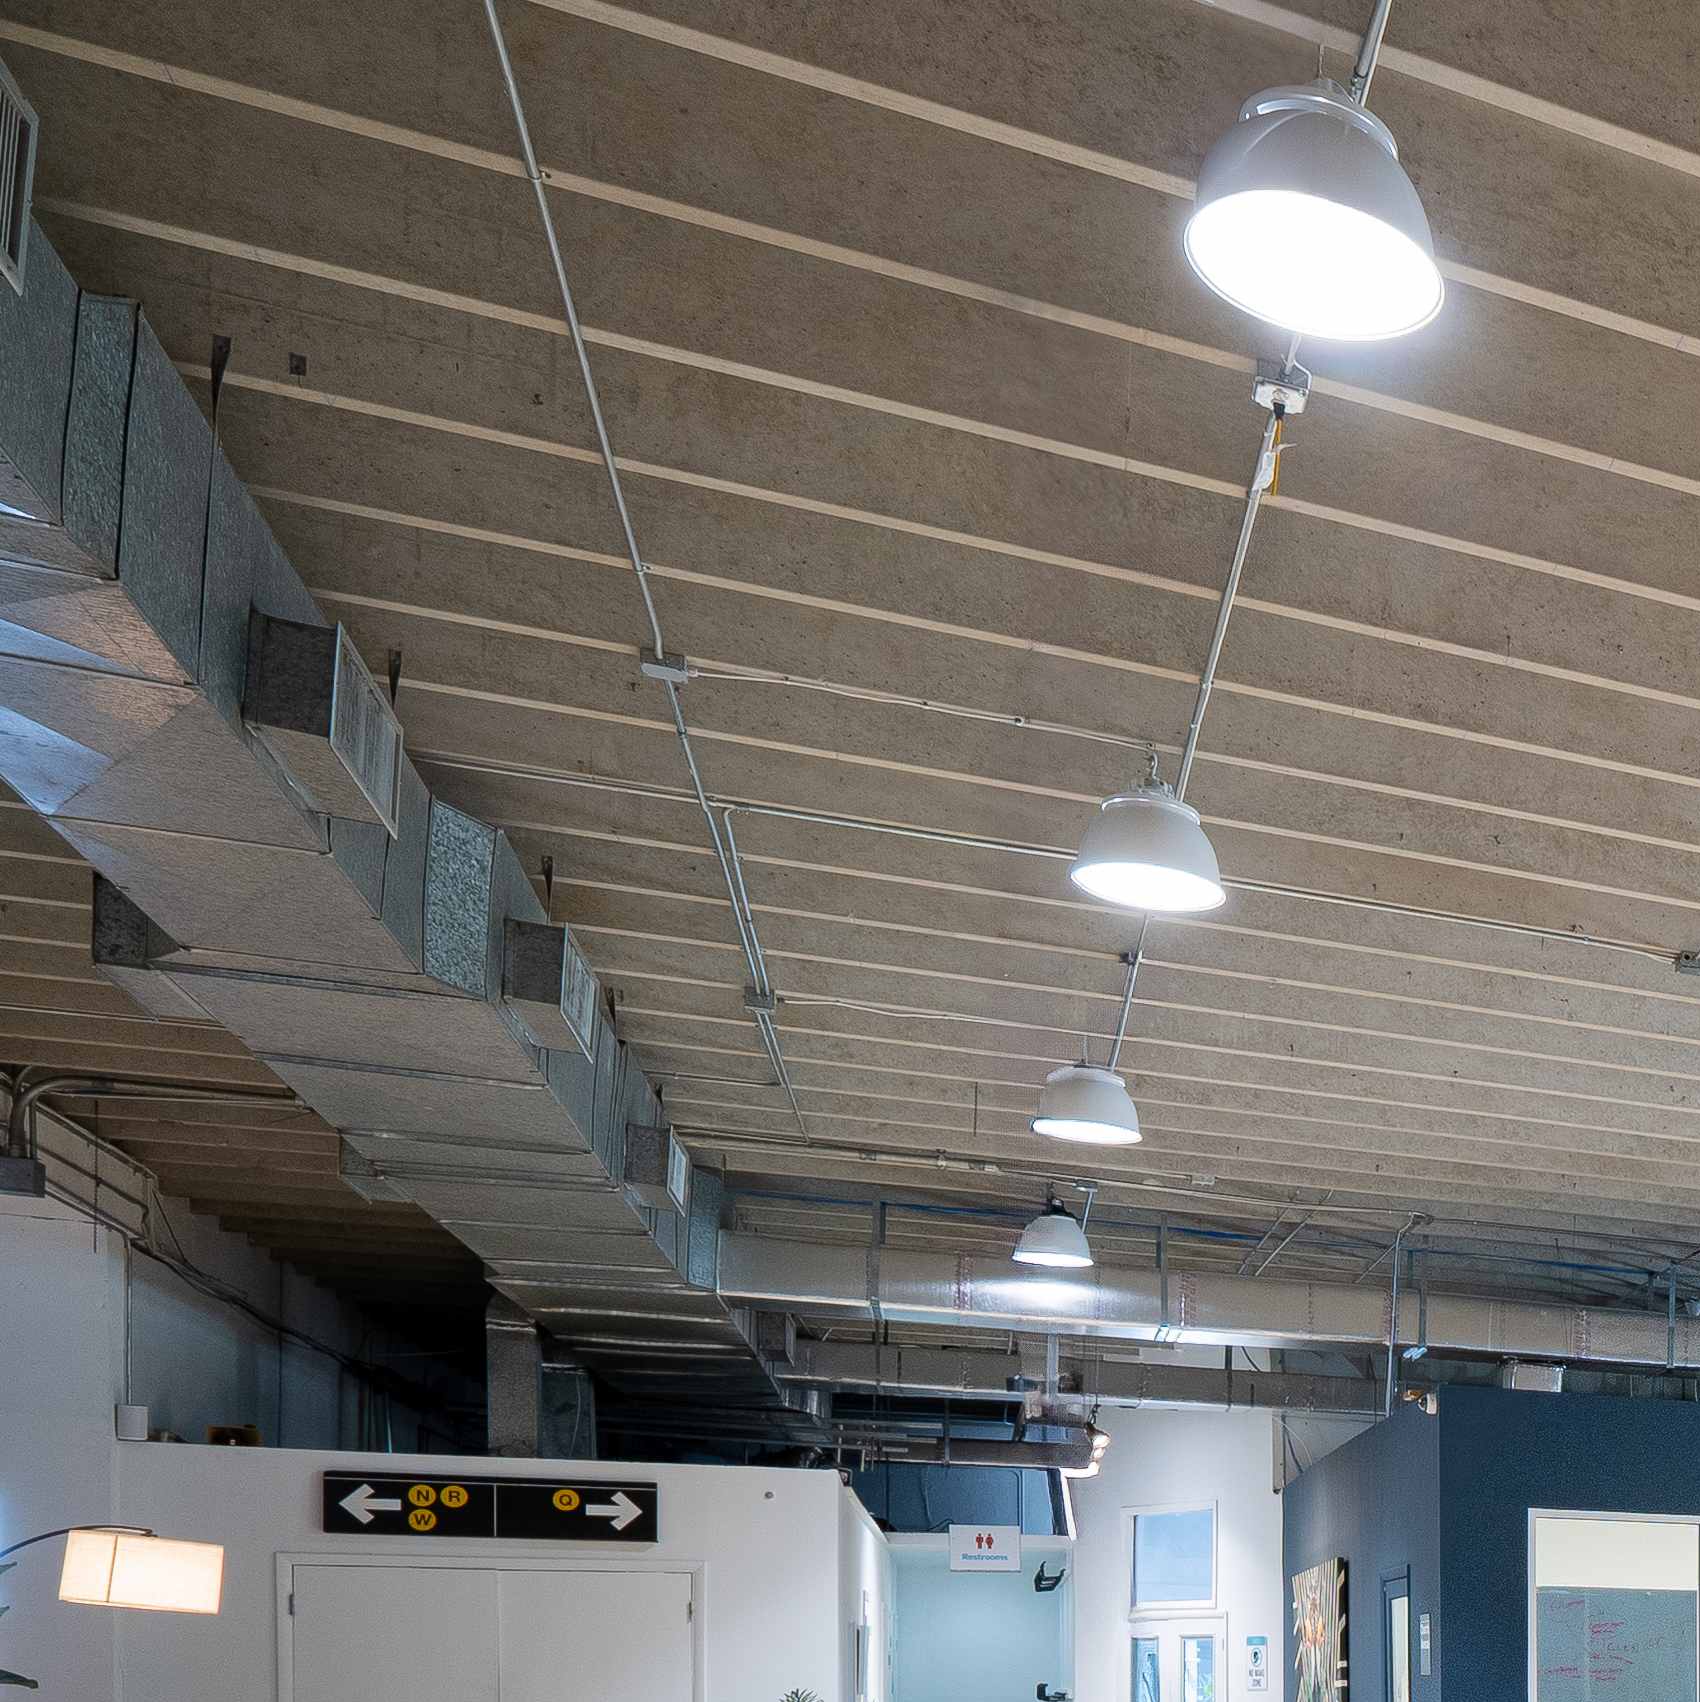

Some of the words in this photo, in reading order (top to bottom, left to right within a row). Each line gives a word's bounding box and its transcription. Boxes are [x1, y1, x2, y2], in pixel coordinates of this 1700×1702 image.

[416, 1490, 430, 1500] N
[448, 1490, 461, 1501] R
[559, 1494, 573, 1506] Q
[414, 1514, 431, 1526] W
[961, 1553, 1008, 1561] Restrooms
